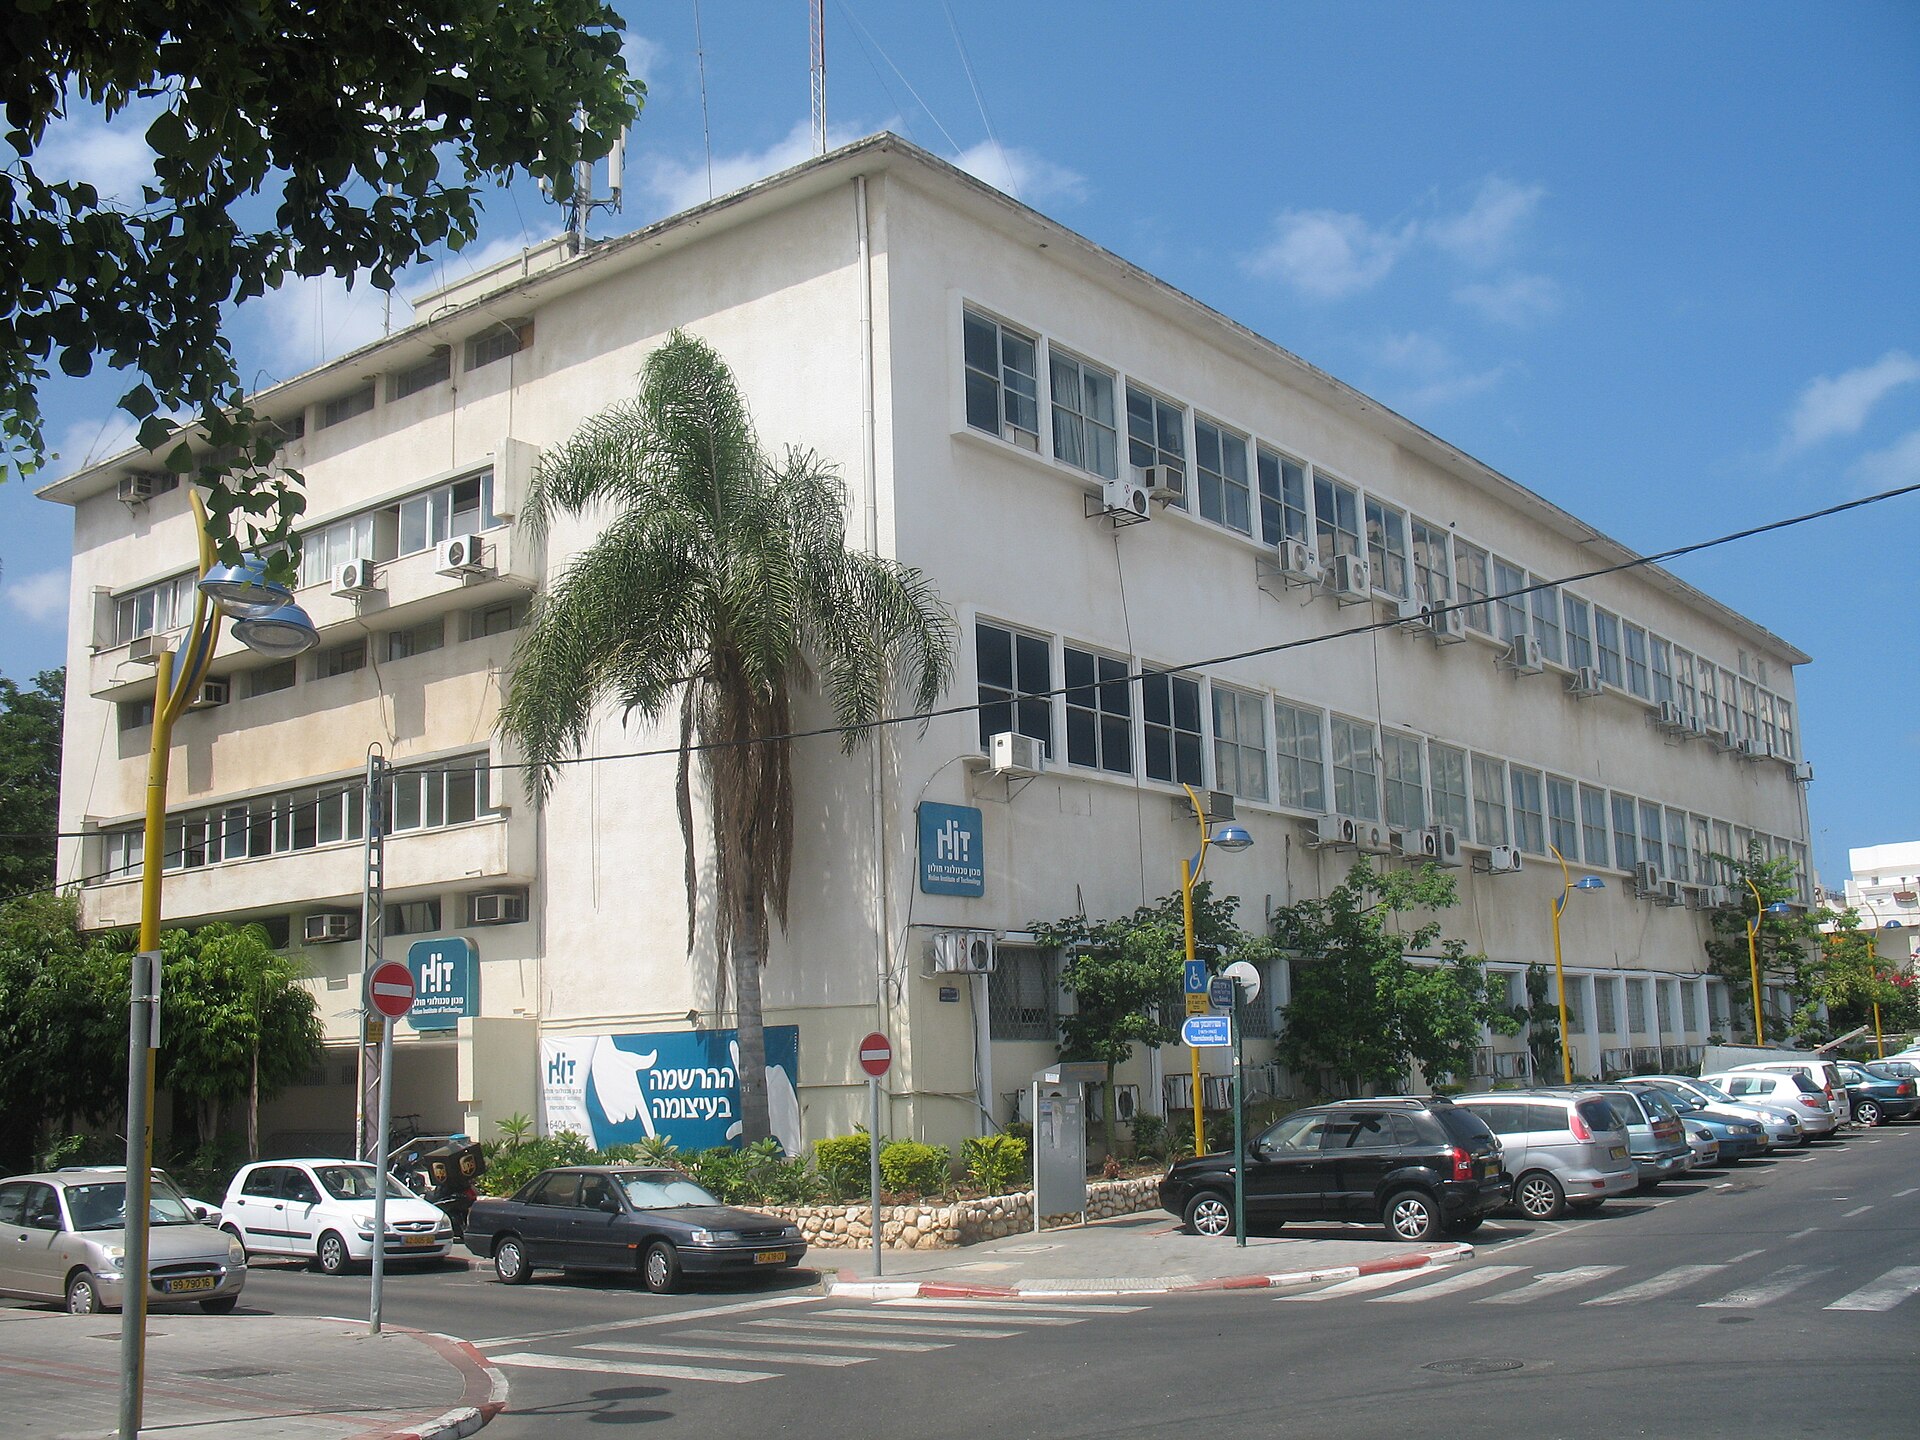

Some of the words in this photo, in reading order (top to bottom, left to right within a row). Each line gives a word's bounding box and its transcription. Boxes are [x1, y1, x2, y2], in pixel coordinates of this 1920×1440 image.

[927, 863, 943, 873] חולון
[968, 868, 981, 877] מכון
[450, 996, 464, 1006] מכון
[650, 1067, 734, 1090] ההרשמה
[652, 1096, 732, 1121] בעיצומה
